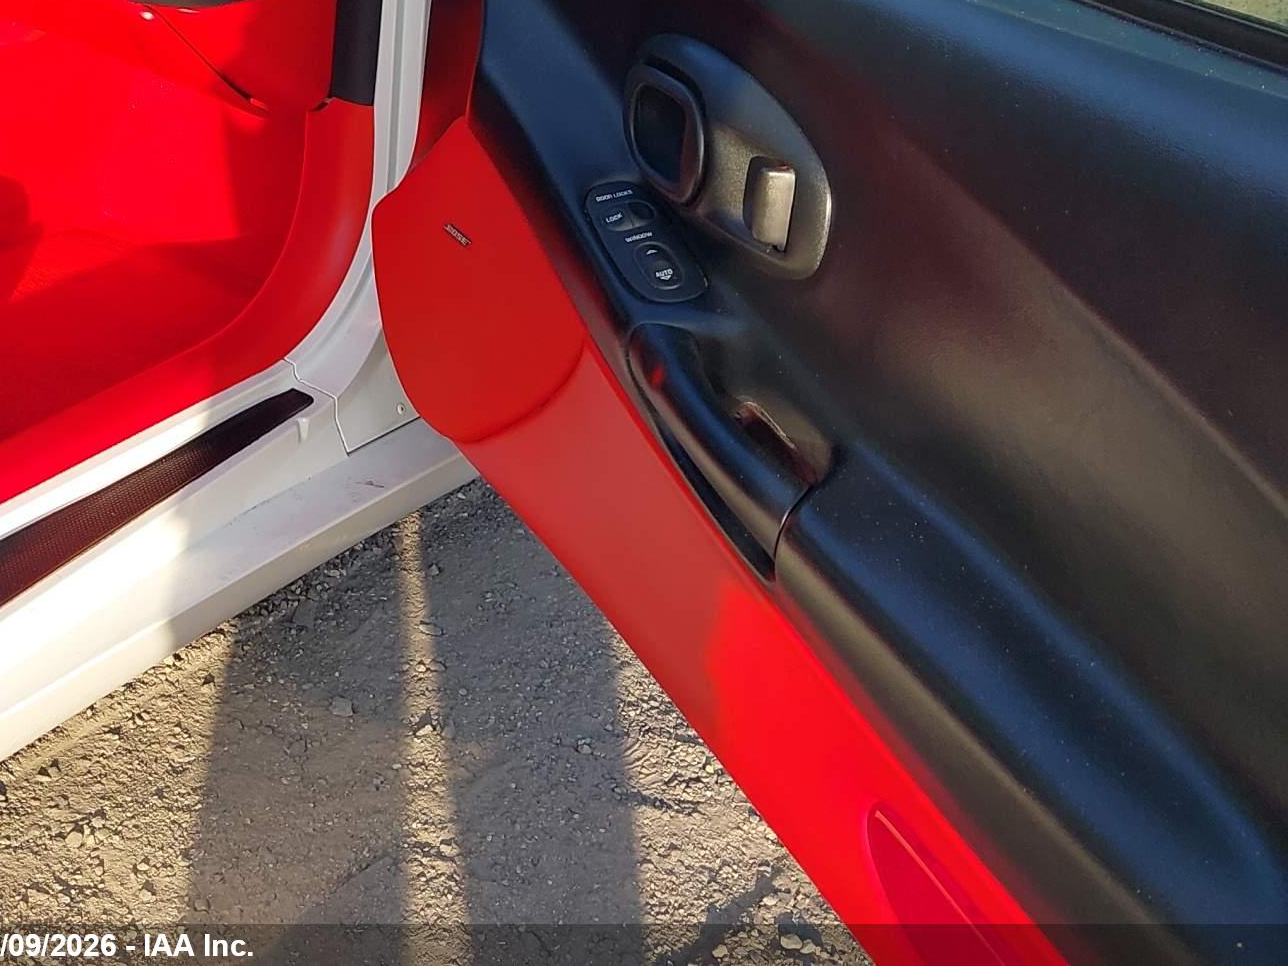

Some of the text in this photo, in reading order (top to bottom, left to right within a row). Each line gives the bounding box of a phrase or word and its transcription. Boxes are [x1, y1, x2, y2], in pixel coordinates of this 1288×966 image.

[605, 212, 622, 223] LOCK
[624, 231, 653, 242] WINDOW
[655, 268, 673, 278] AUTO
